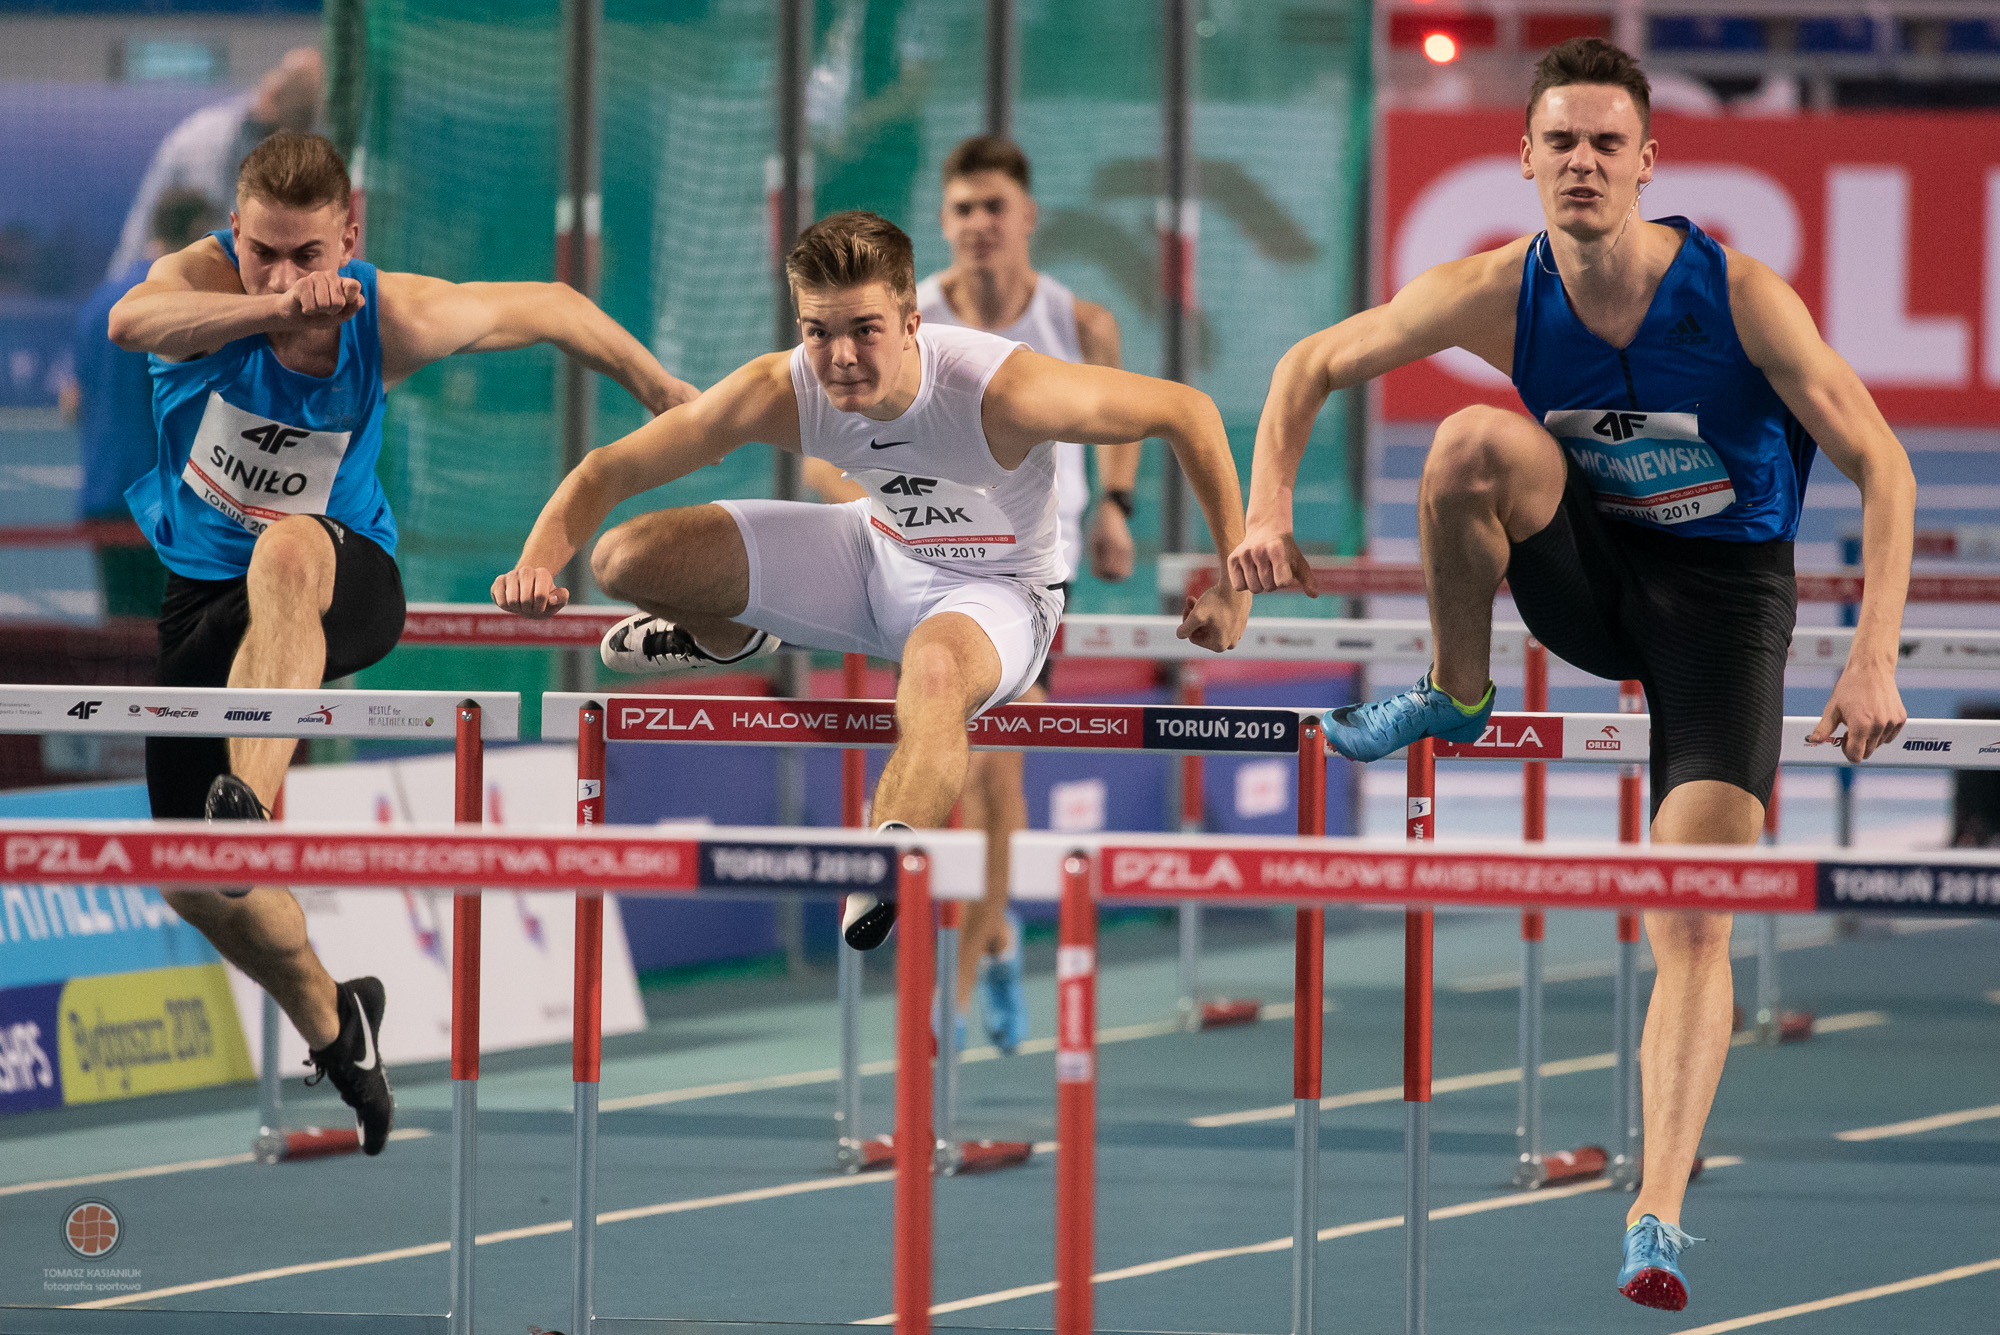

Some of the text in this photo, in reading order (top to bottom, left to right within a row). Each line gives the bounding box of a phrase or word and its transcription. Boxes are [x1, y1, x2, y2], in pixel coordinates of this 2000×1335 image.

[1592, 411, 1648, 442] 4F
[240, 423, 311, 455] 4F
[209, 444, 307, 496] SINIŁO
[1569, 447, 1715, 483] MICHNIEWSKI
[879, 474, 938, 497] 4F
[204, 488, 246, 526] TORUŃ
[250, 519, 269, 535] 20
[1662, 501, 1701, 521] 2019
[951, 546, 986, 559] 2019
[67, 700, 103, 720] 4F
[223, 710, 273, 721] 4MOVE
[297, 715, 325, 724] polanik
[621, 707, 715, 731] PZLA
[732, 711, 838, 730] HALOWE
[1039, 717, 1128, 735] POLSKI
[1156, 716, 1229, 739] TORUŃ
[1234, 720, 1286, 740] 2019
[1466, 725, 1544, 748] ZLA
[1587, 741, 1620, 750] ORLEN
[1902, 740, 1953, 752] 4MOVE
[1977, 745, 2000, 755] polan
[4, 836, 133, 874] PZLA
[151, 842, 295, 873] HALOWE
[302, 843, 552, 876] MISTRZOSTWA
[555, 847, 681, 877] POLSKI
[1111, 851, 1245, 890] PZLA
[1260, 857, 1408, 890] HALOWE
[1411, 860, 1667, 896] MISTRZOSTWA
[1671, 866, 1800, 899] POLSKI
